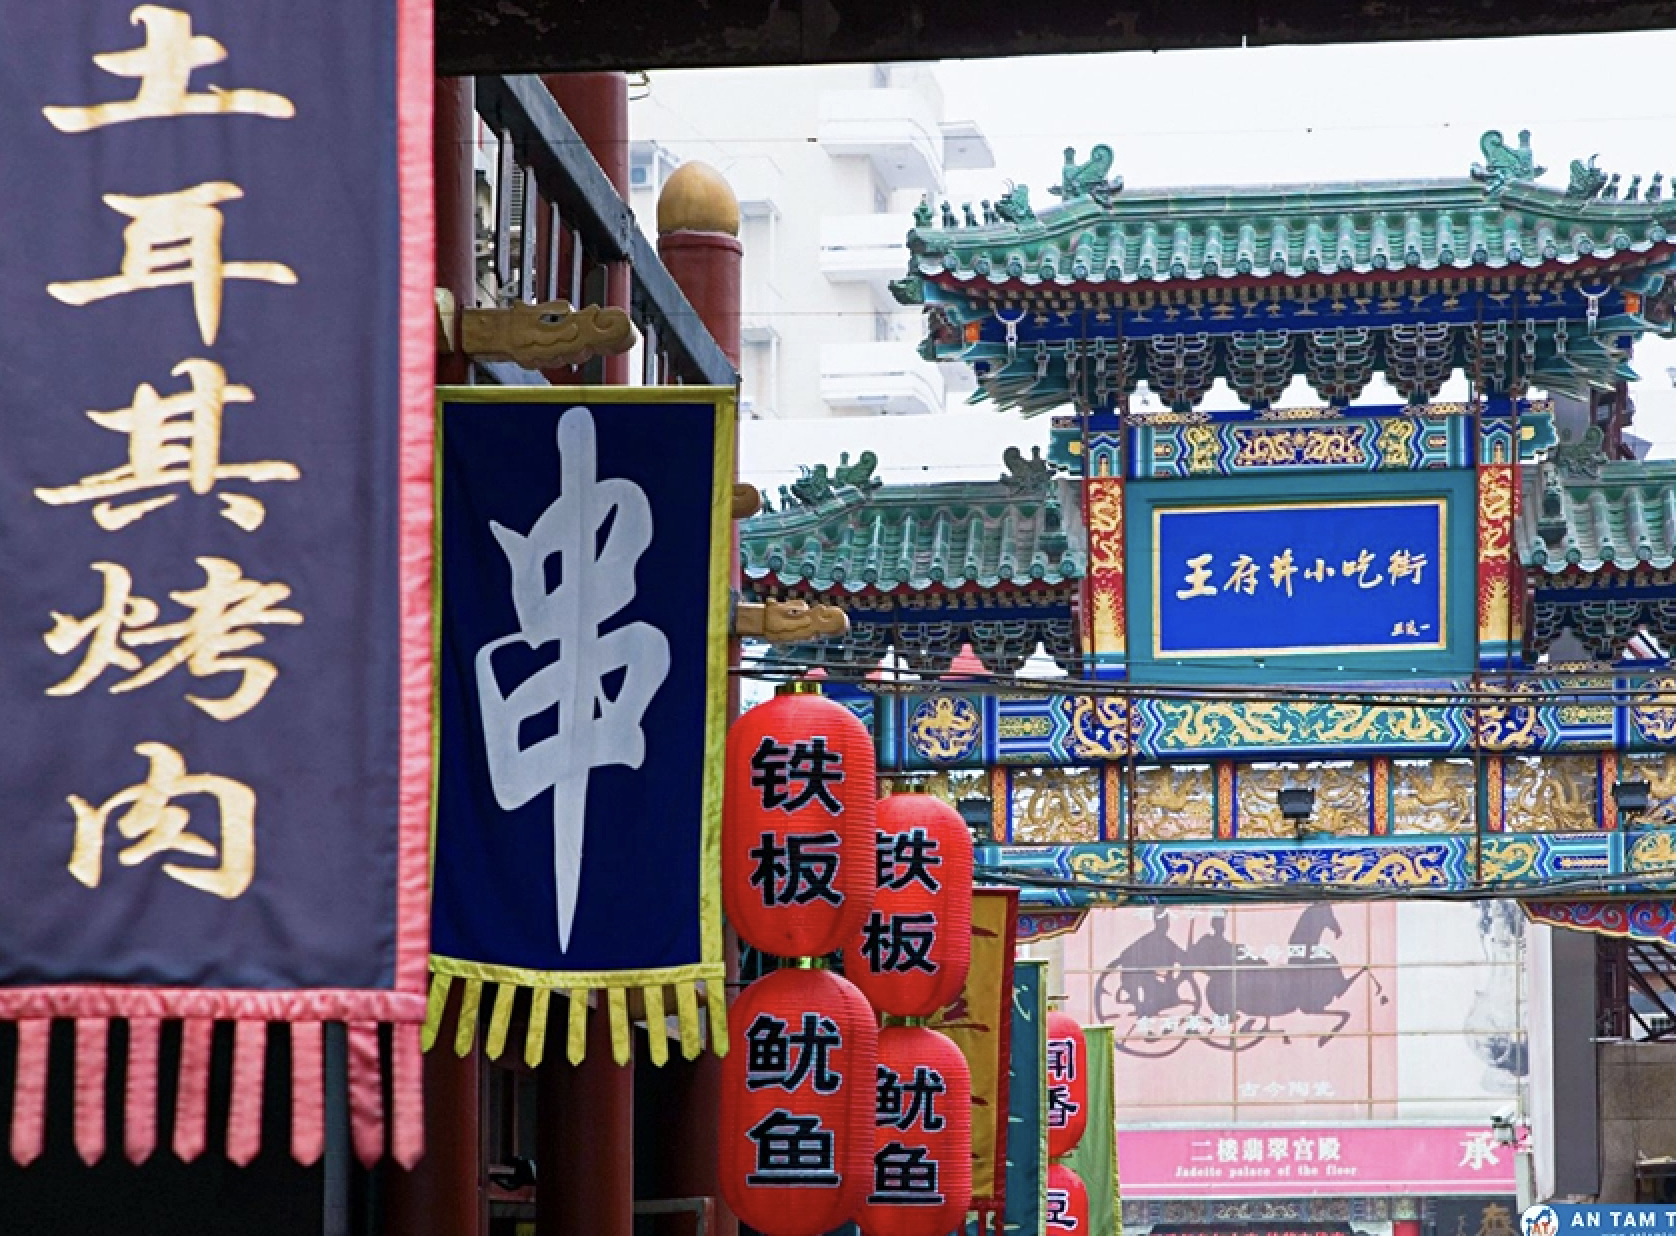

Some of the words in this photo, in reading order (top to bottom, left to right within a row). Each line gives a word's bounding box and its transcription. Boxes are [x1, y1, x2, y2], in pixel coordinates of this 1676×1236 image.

[33, 3, 304, 900] 土耳其烤肉
[1175, 547, 1429, 600] 王府井小吃街
[474, 405, 671, 955] 串
[749, 735, 845, 908] 铁板
[860, 828, 943, 975] 铁板
[746, 1011, 843, 1188] 鱿鱼
[866, 1063, 946, 1206] 鱿鱼
[1190, 1136, 1342, 1163] 二楼翡翠宫殿
[1229, 1165, 1271, 1179] palace
[1277, 1164, 1291, 1177] of
[1298, 1165, 1319, 1177] the
[1325, 1164, 1357, 1177] floor
[1457, 1131, 1500, 1171] 承
